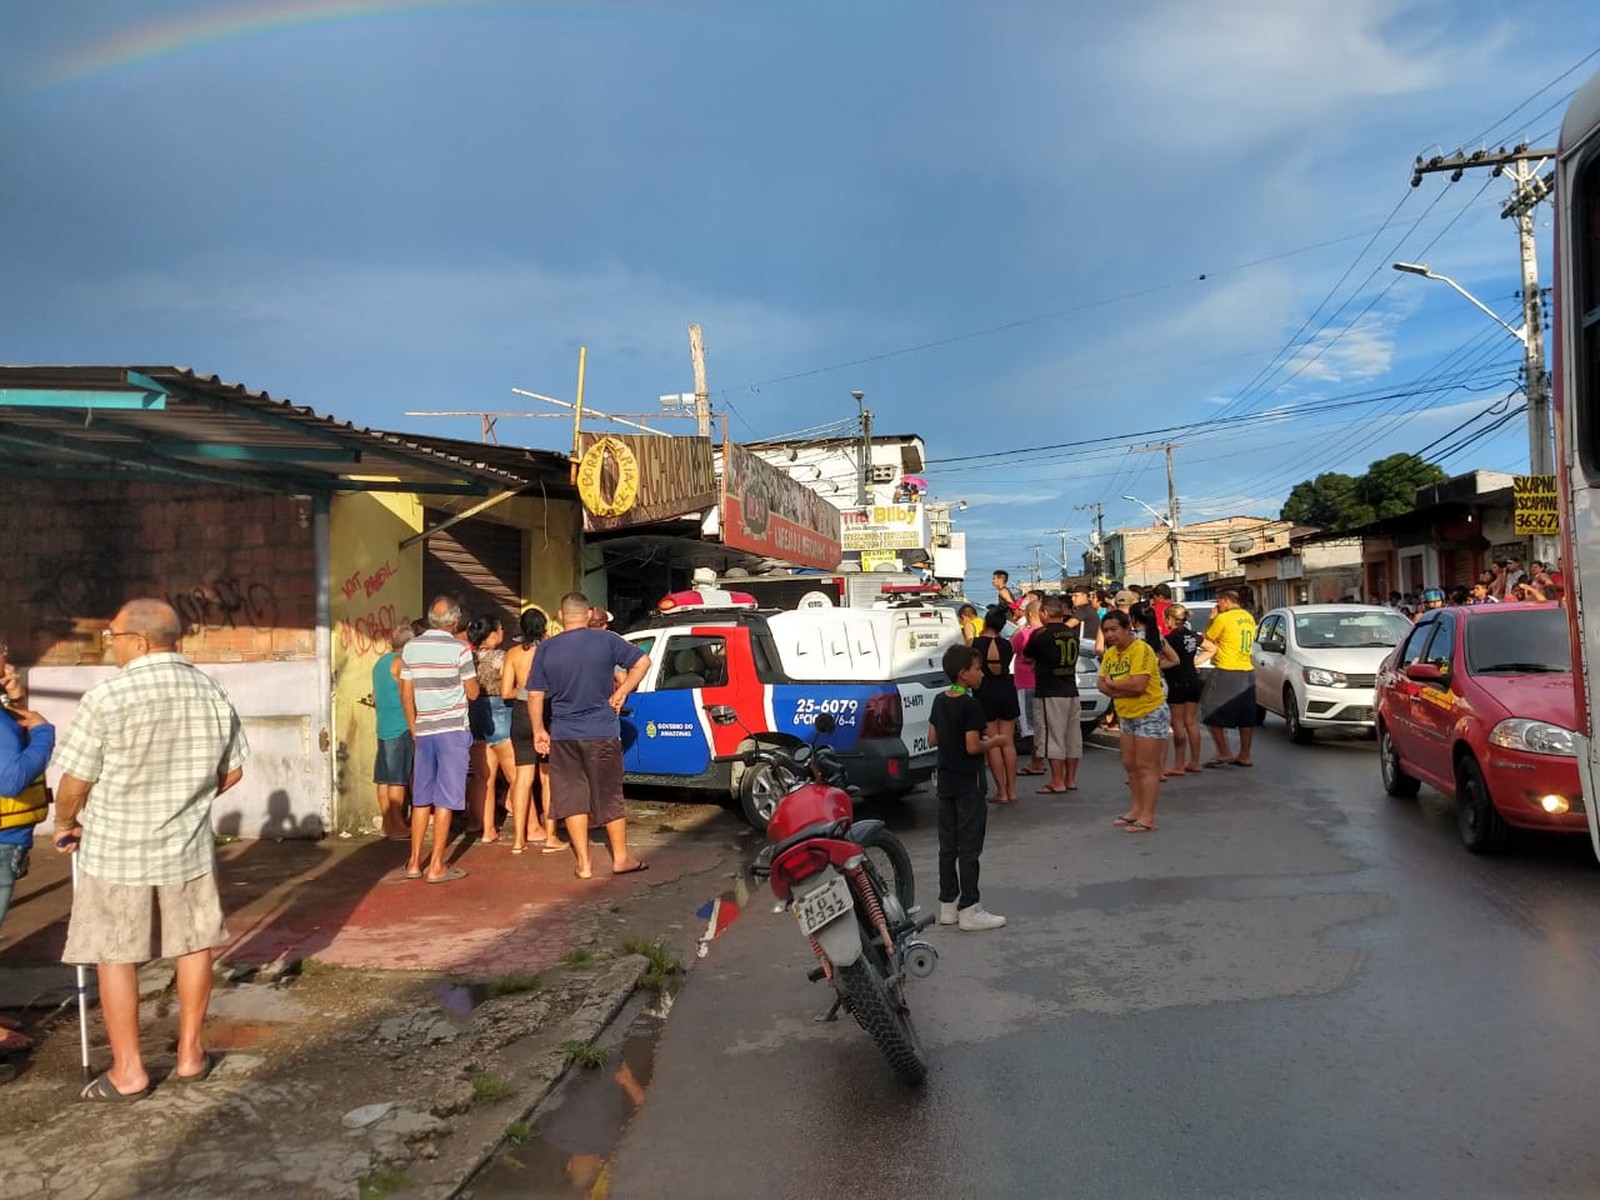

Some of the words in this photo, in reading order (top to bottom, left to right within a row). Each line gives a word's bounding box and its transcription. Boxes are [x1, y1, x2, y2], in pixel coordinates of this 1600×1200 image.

[1054, 638, 1078, 666] 10
[1240, 629, 1252, 653] 10
[795, 698, 858, 714] 25-6079
